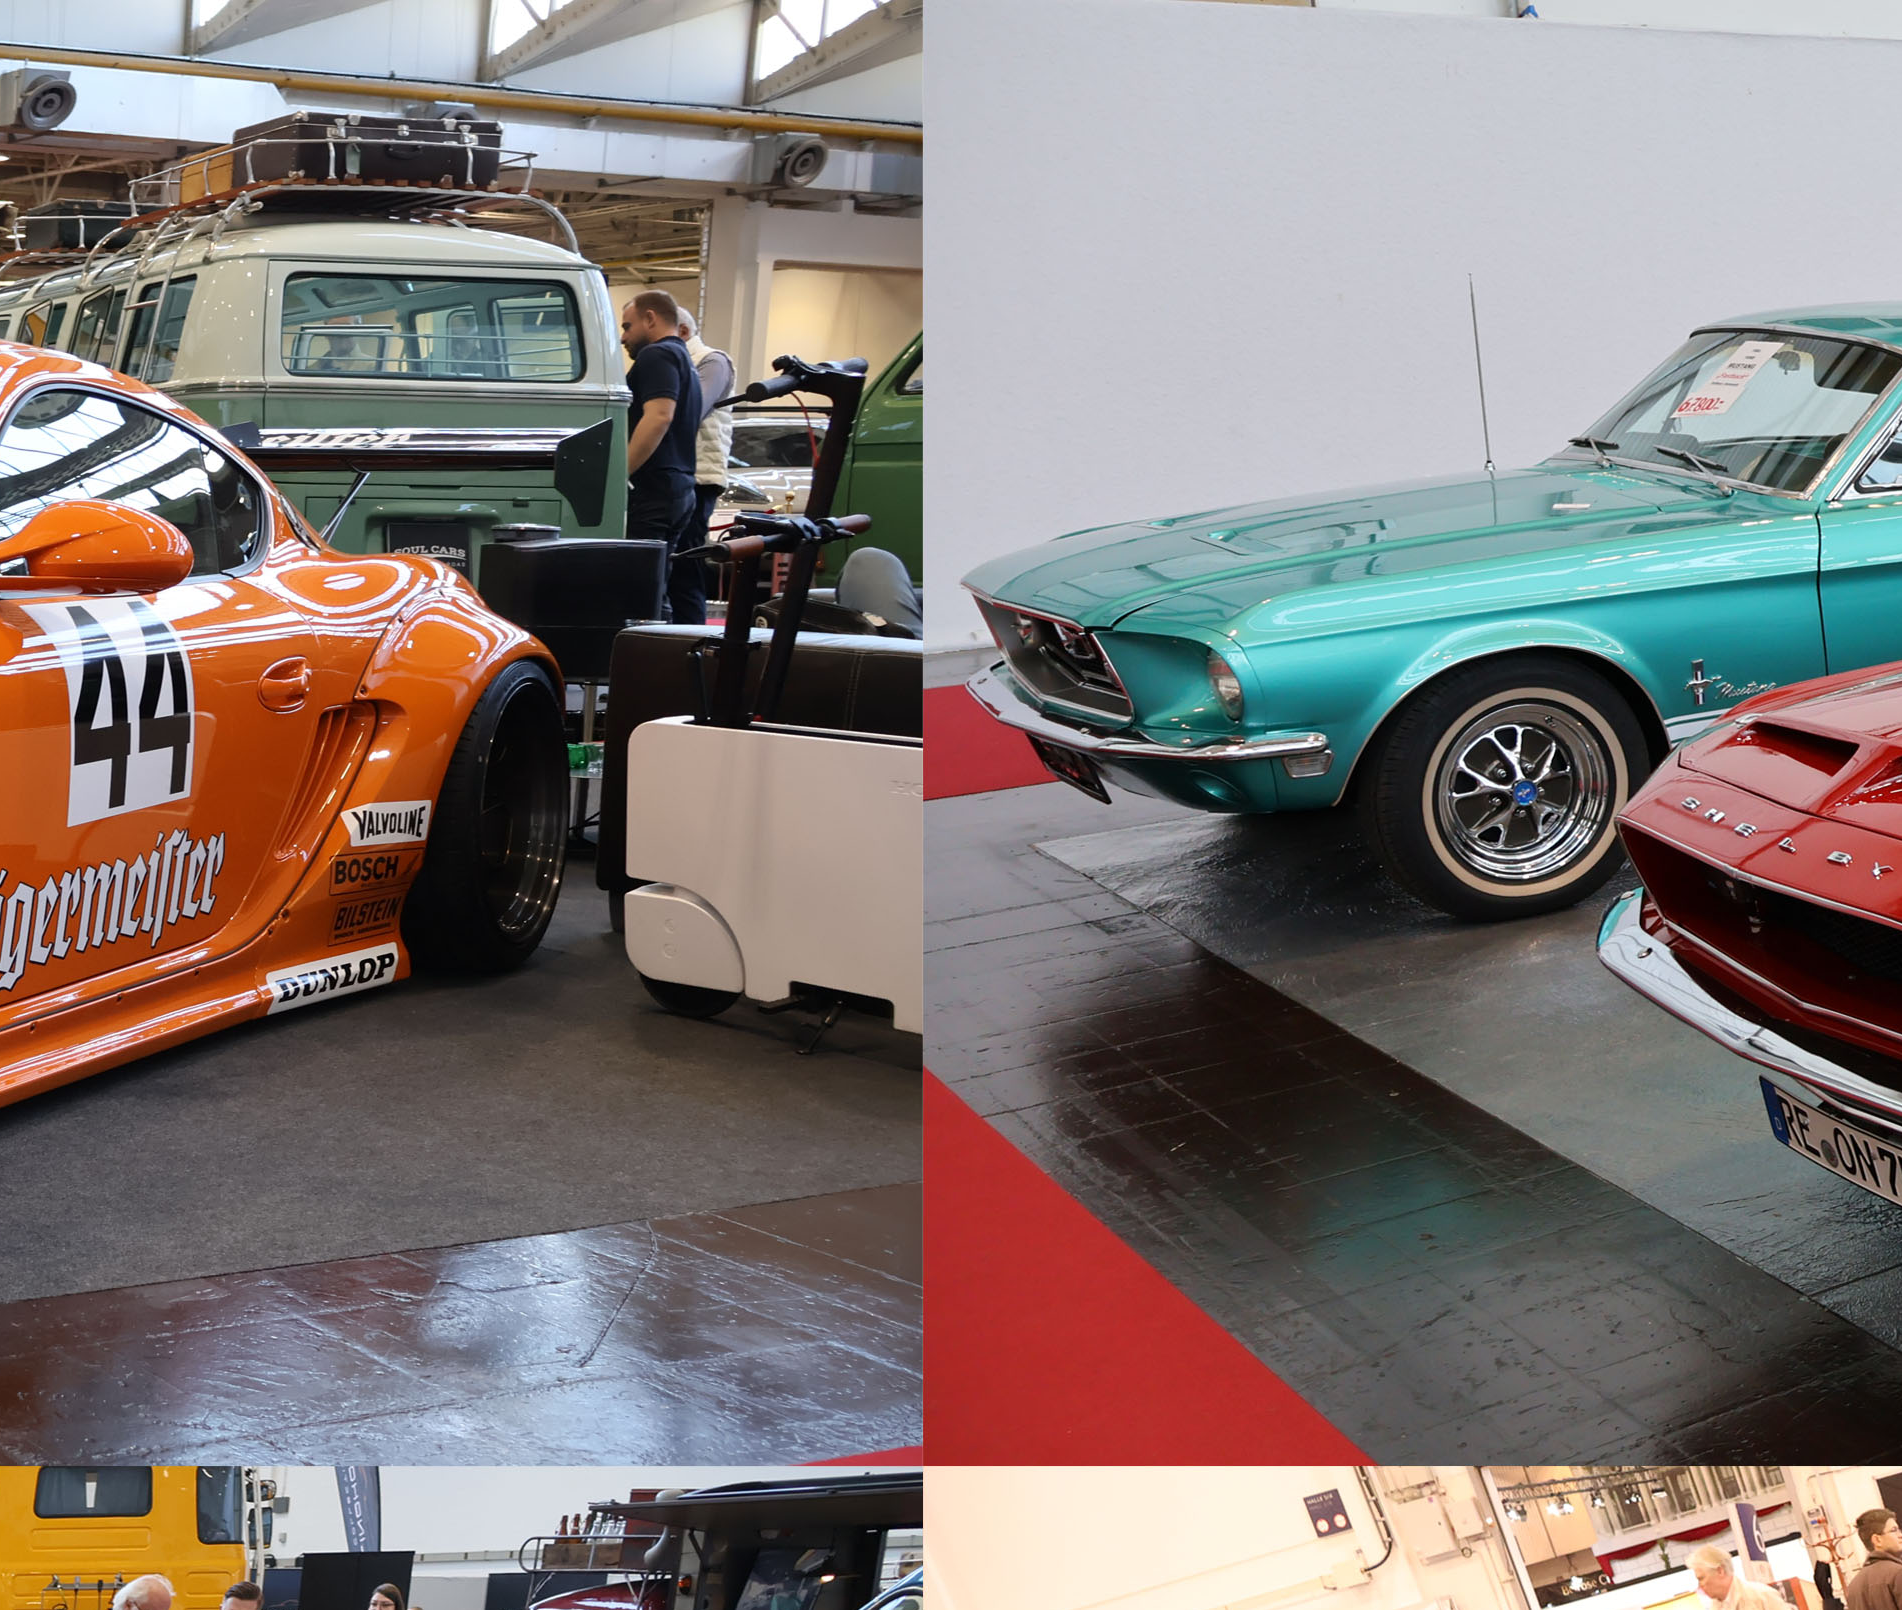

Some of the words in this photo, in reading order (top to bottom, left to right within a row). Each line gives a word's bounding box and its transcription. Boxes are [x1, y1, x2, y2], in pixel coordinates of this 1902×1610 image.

[430, 545, 466, 558] CARS
[65, 600, 191, 810] 44
[351, 805, 427, 841] VALVOLINE
[1681, 796, 1895, 881] SHELBY
[334, 855, 400, 885] BOSCH
[334, 896, 402, 930] BILSTEIN
[275, 953, 396, 1003] DUNLOP
[1777, 1094, 1821, 1158] RE
